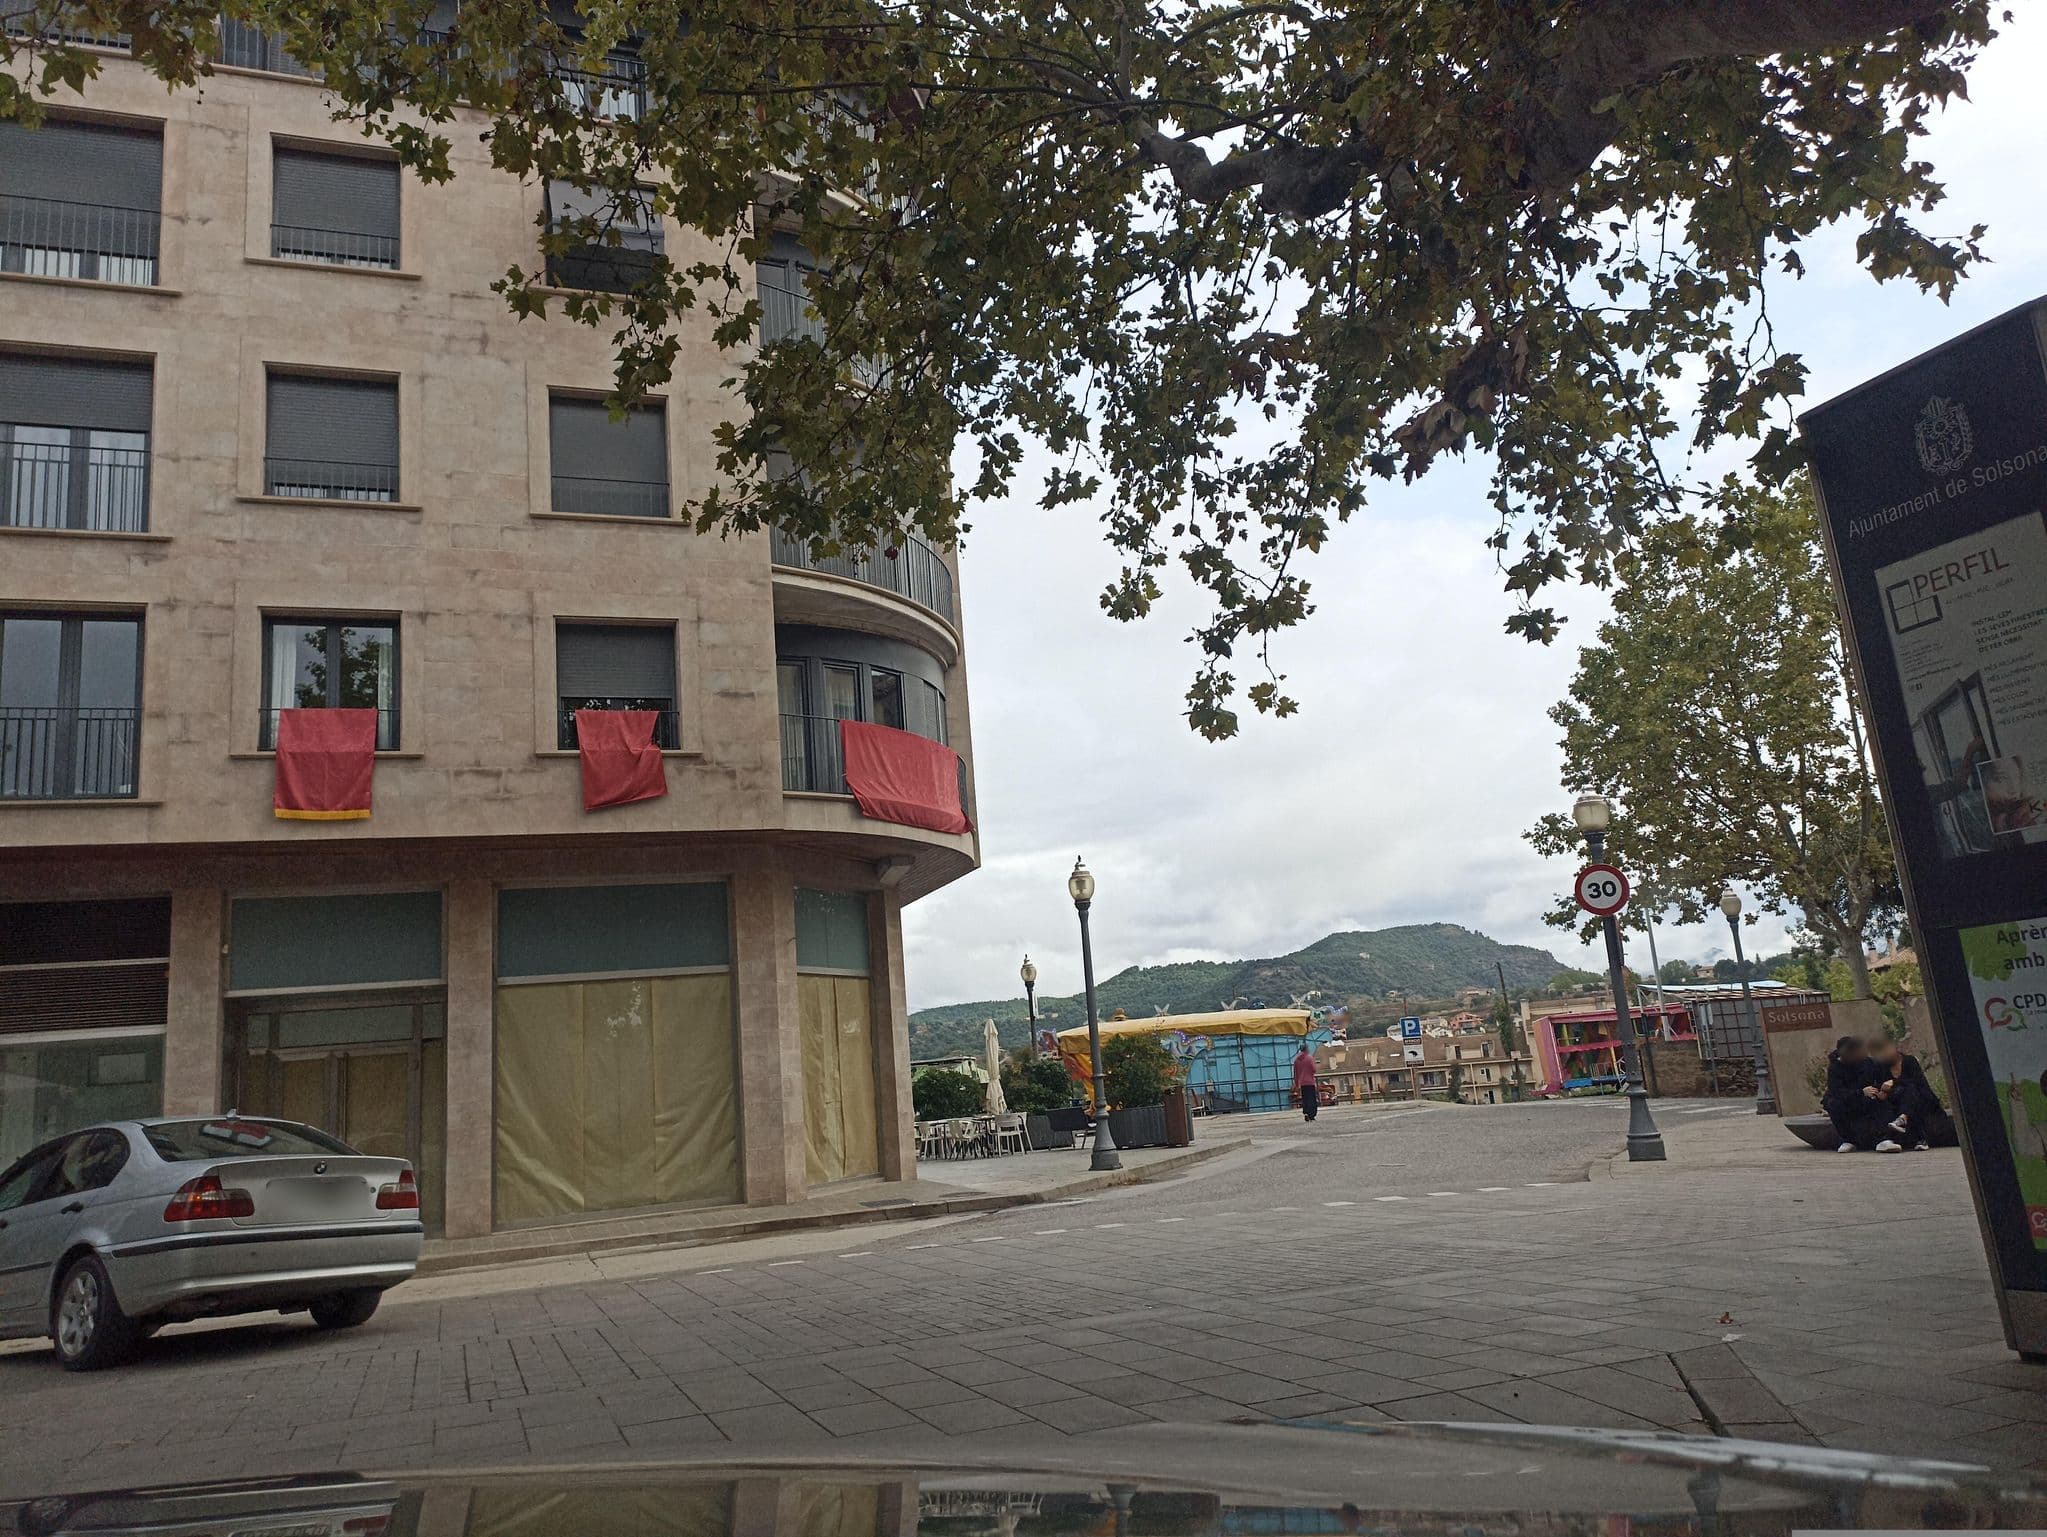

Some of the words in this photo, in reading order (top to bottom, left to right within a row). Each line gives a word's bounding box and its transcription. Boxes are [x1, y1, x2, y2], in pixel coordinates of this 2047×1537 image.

[1849, 486, 1942, 538] Ajuntament
[1945, 478, 1968, 499] de
[1972, 444, 2047, 487] Solsona
[1912, 546, 2010, 598] PERFIL
[1587, 880, 1617, 899] 30
[2003, 951, 2045, 971] amb
[1768, 1009, 1825, 1024] Solsona
